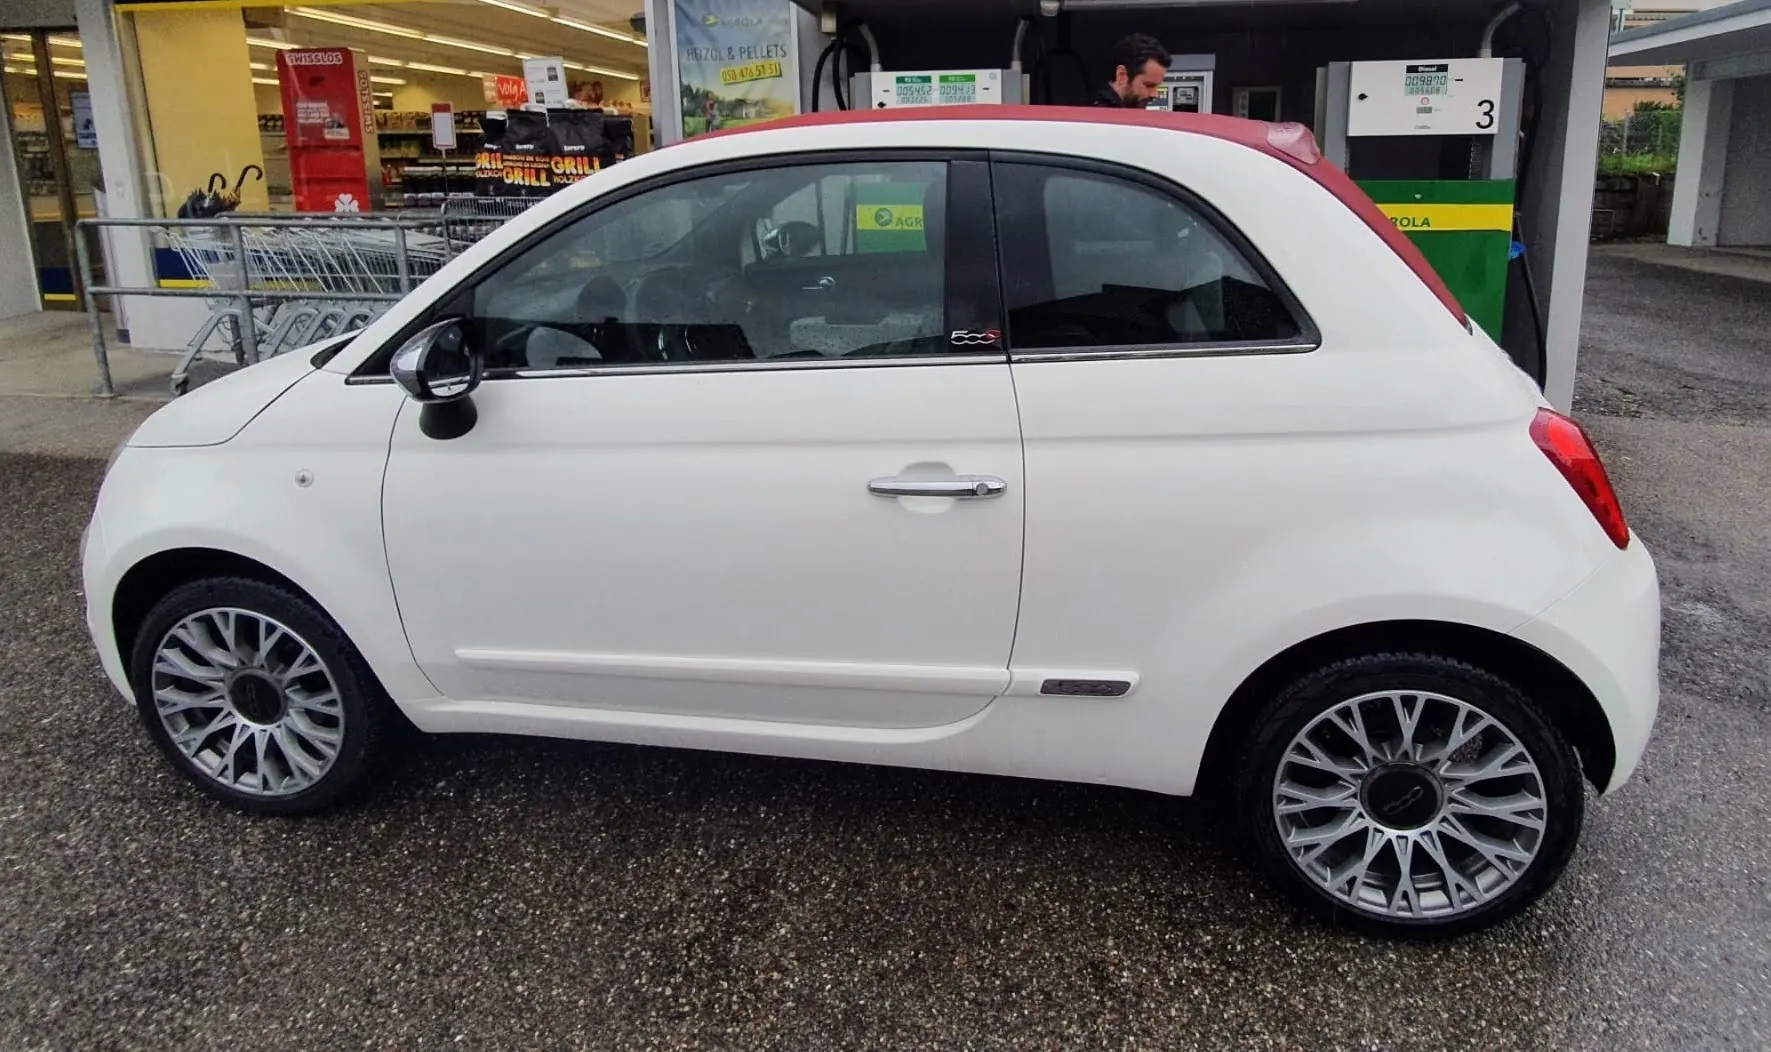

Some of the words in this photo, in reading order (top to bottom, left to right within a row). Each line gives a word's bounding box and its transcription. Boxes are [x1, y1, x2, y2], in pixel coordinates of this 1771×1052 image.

[286, 52, 343, 66] SWISSLOS
[739, 44, 787, 60] PELLETS
[1418, 65, 1438, 73] Diesel
[358, 70, 375, 136] SWISSLOS
[1475, 99, 1495, 129] 3
[502, 166, 551, 187] GRILL
[950, 330, 996, 345] 500
